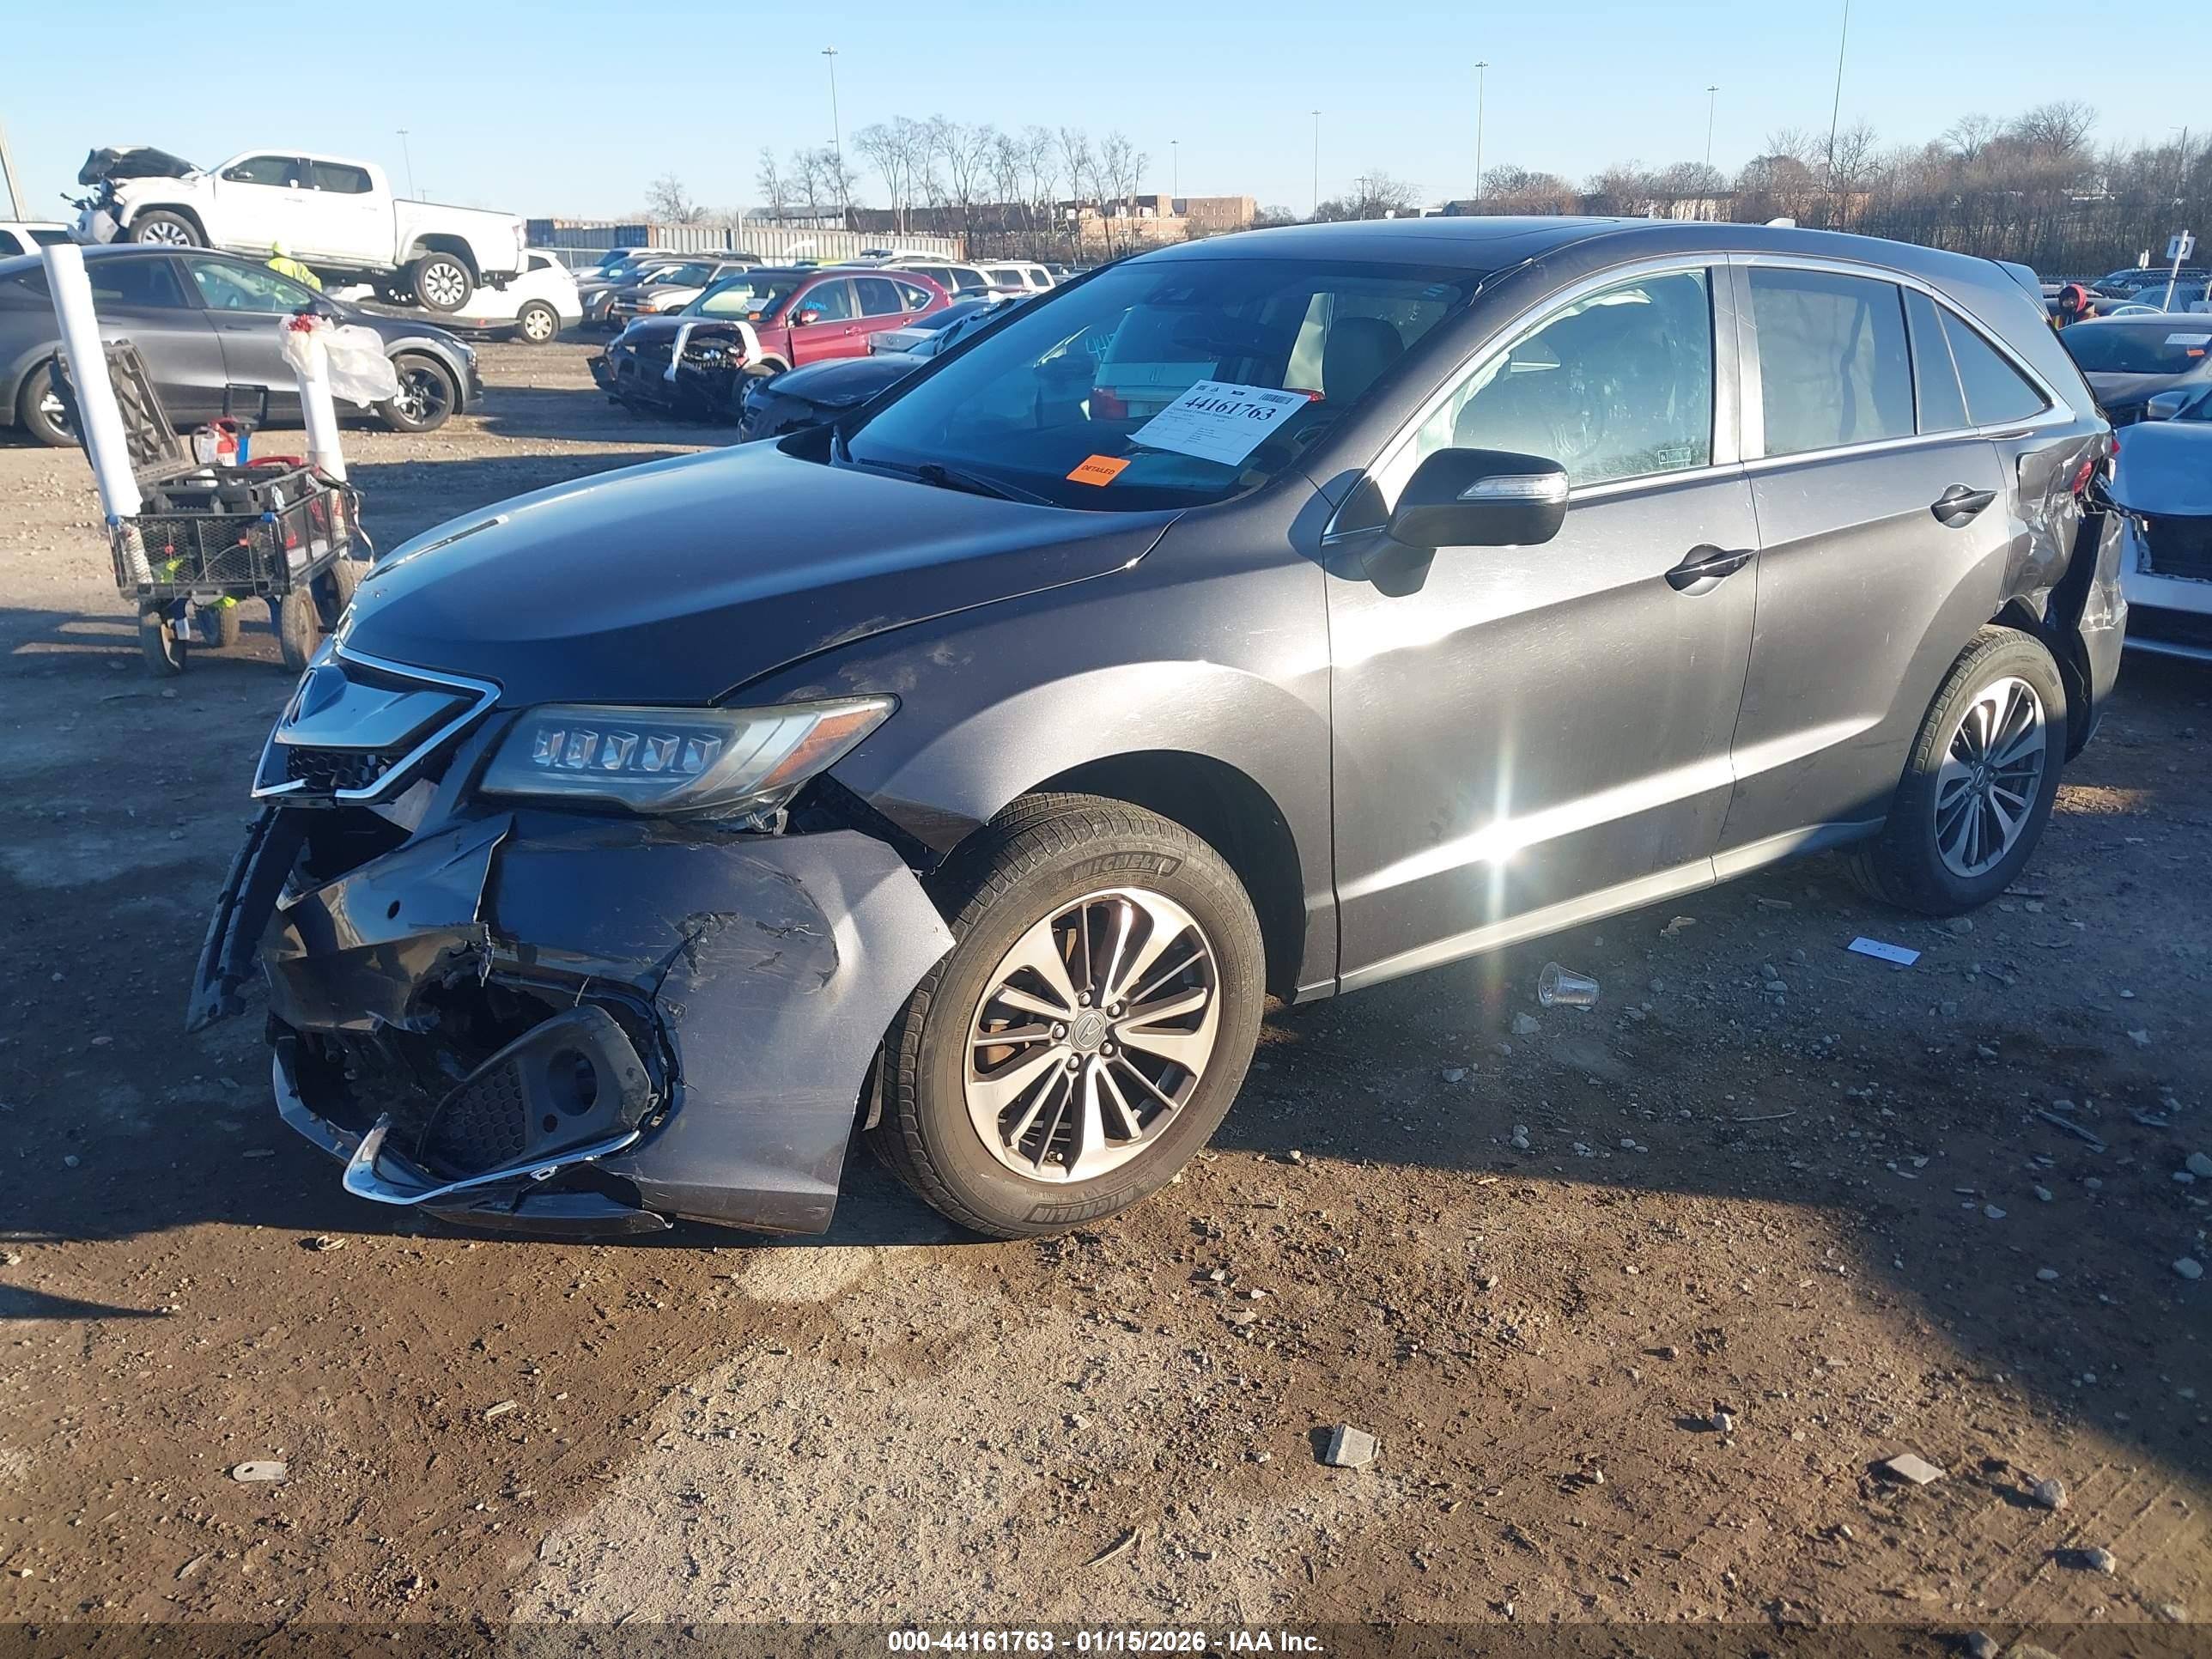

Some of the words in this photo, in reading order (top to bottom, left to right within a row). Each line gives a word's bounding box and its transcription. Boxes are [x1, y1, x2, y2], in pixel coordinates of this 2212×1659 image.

[1185, 396, 1277, 421] 44161763
[1081, 465, 1115, 475] DETAILED
[1073, 854, 1178, 880] MICHELIN
[1030, 1187, 1135, 1223] MICHELIN
